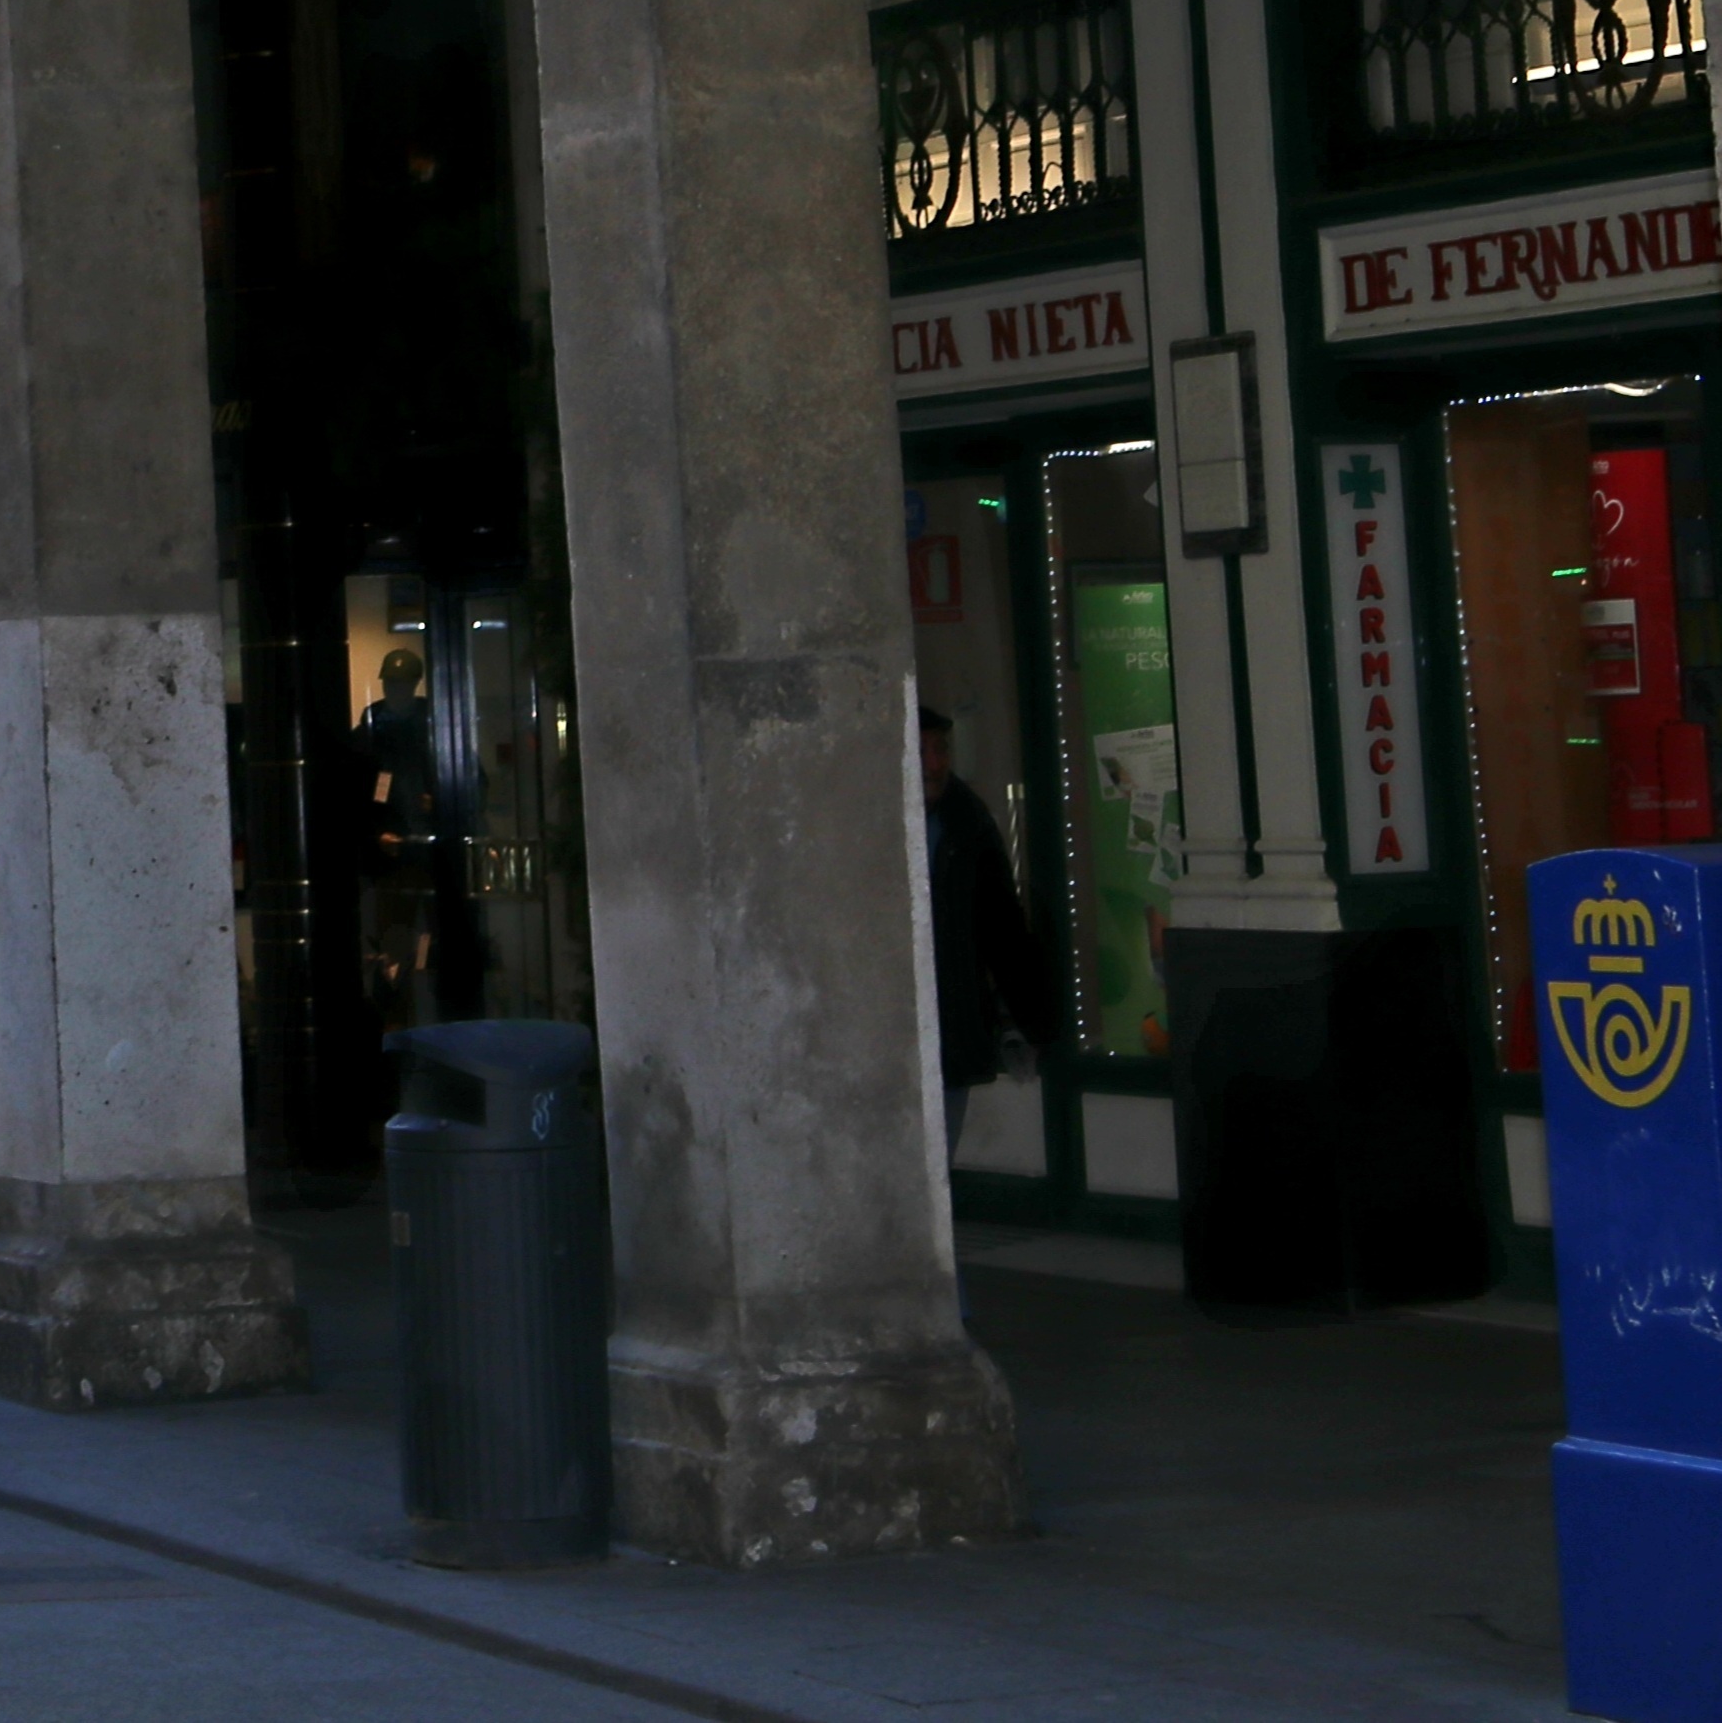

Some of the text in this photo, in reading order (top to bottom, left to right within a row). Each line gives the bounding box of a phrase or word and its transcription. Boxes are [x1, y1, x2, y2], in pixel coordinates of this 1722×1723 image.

[1340, 247, 1413, 314] DE
[987, 290, 1134, 362] NIETA
[1355, 518, 1403, 865] FARMACIA
